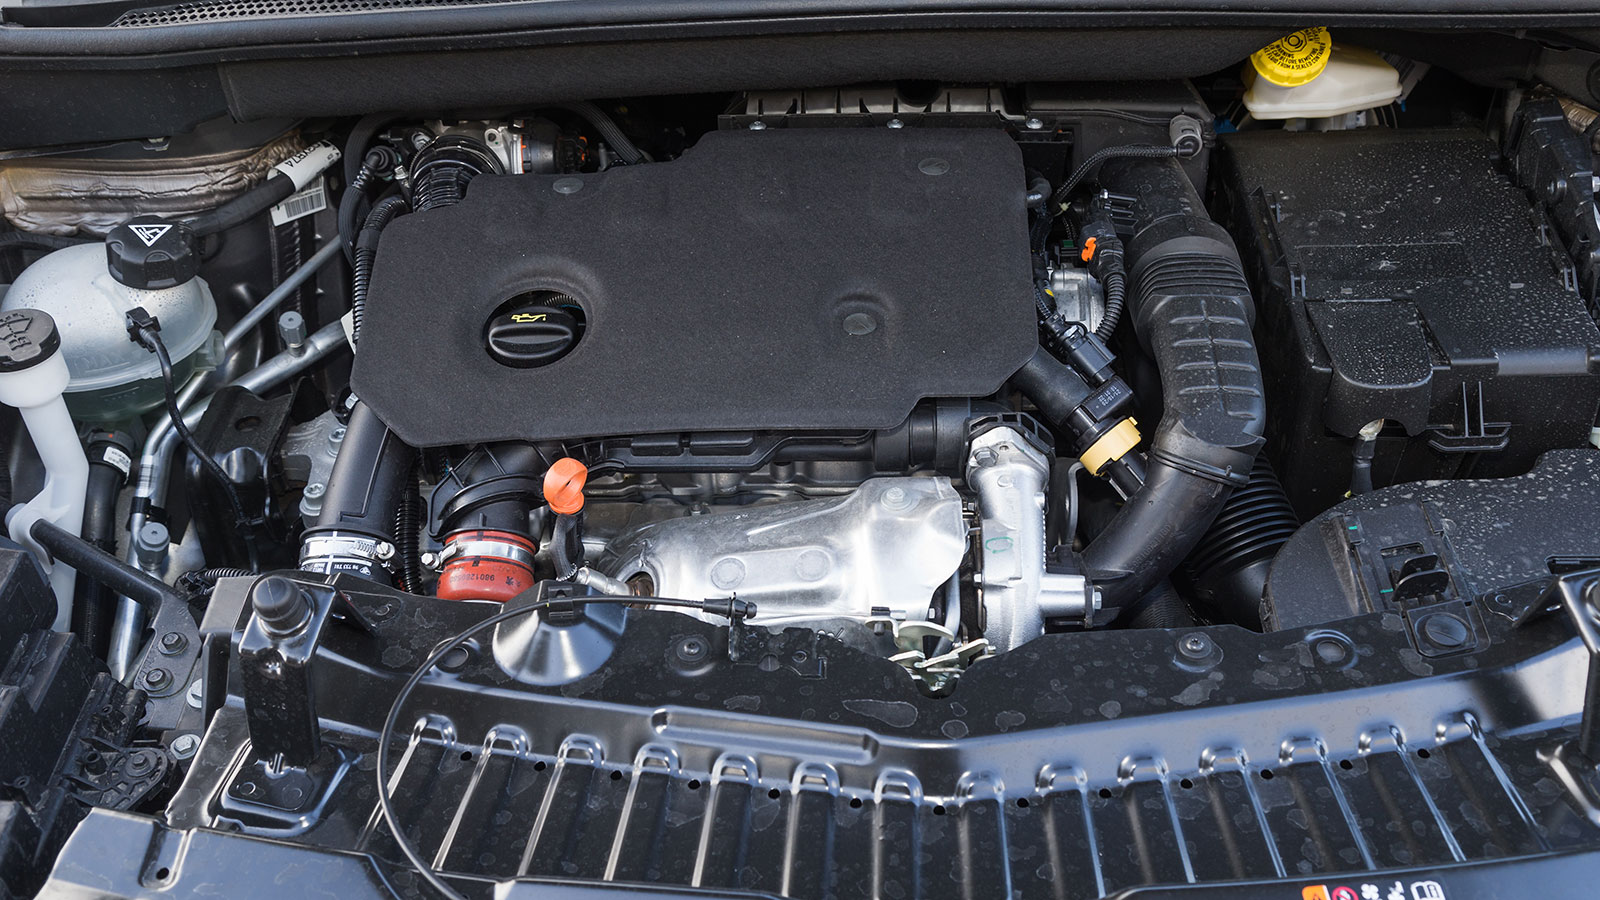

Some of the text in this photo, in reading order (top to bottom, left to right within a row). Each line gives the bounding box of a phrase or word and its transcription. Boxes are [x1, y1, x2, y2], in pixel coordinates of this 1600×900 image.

[1279, 55, 1297, 65] BEFORE
[1298, 47, 1319, 64] REMOVING
[1278, 61, 1291, 69] FROM
[1296, 61, 1313, 70] SEALED
